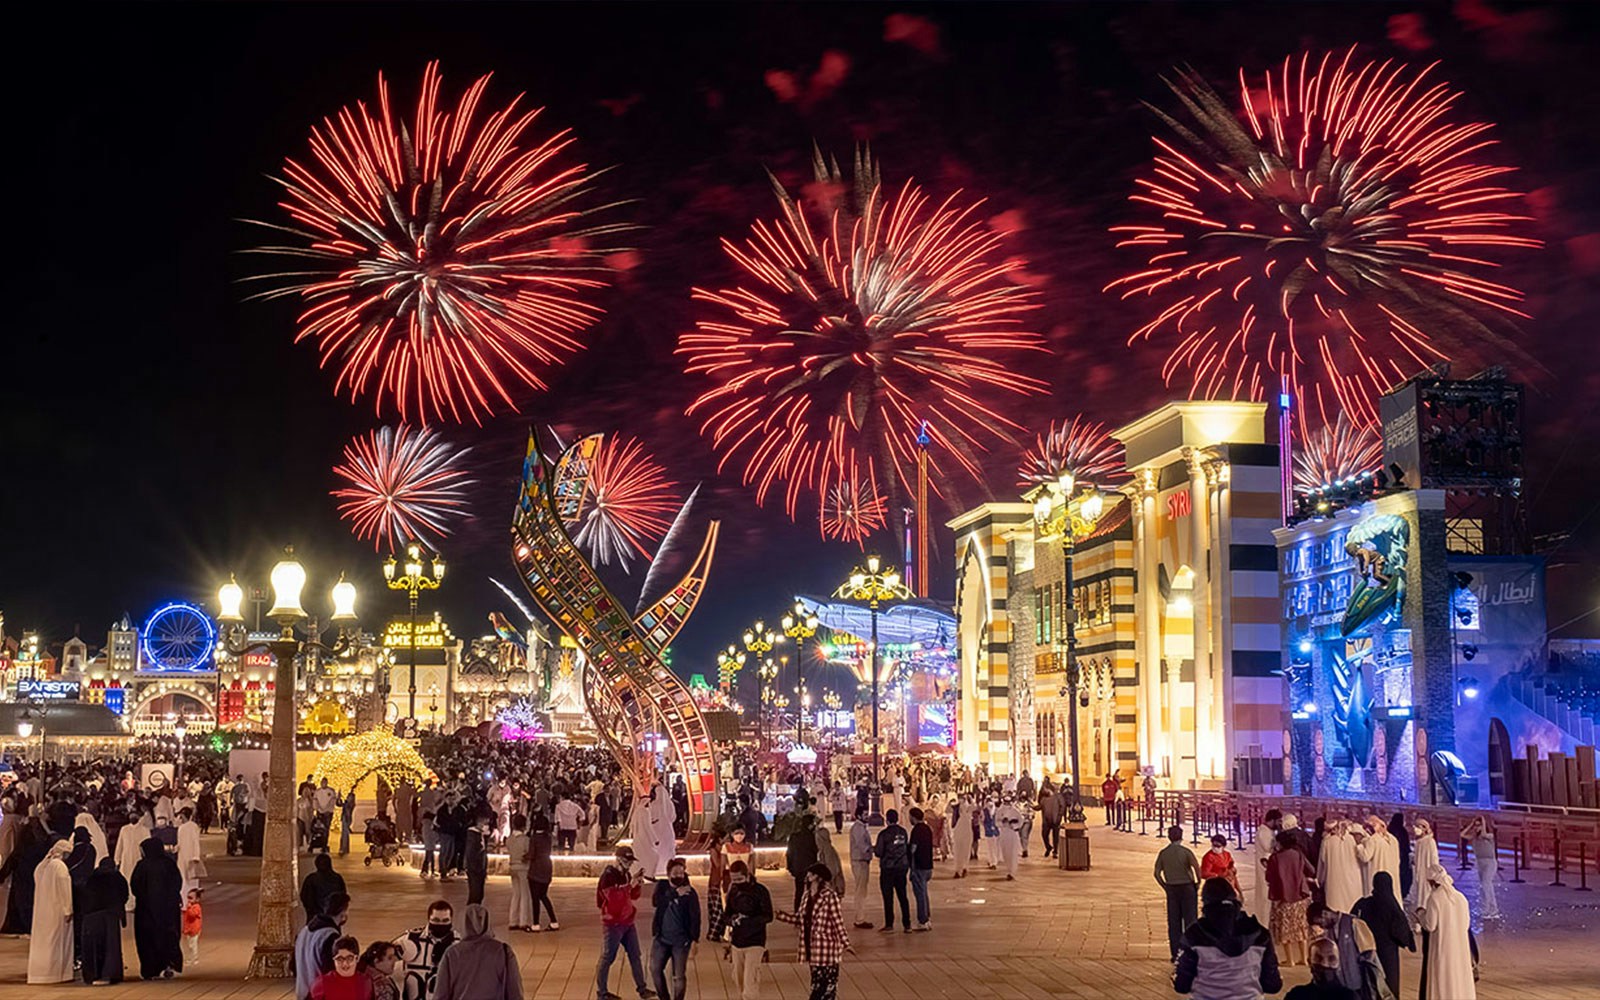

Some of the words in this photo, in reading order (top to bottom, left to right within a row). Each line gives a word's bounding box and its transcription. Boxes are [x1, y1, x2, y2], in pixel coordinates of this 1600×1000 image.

[1386, 424, 1416, 452] FORCE
[1167, 490, 1191, 520] SYRI
[1491, 573, 1537, 605] أبطال
[18, 681, 79, 693] BARISTA
